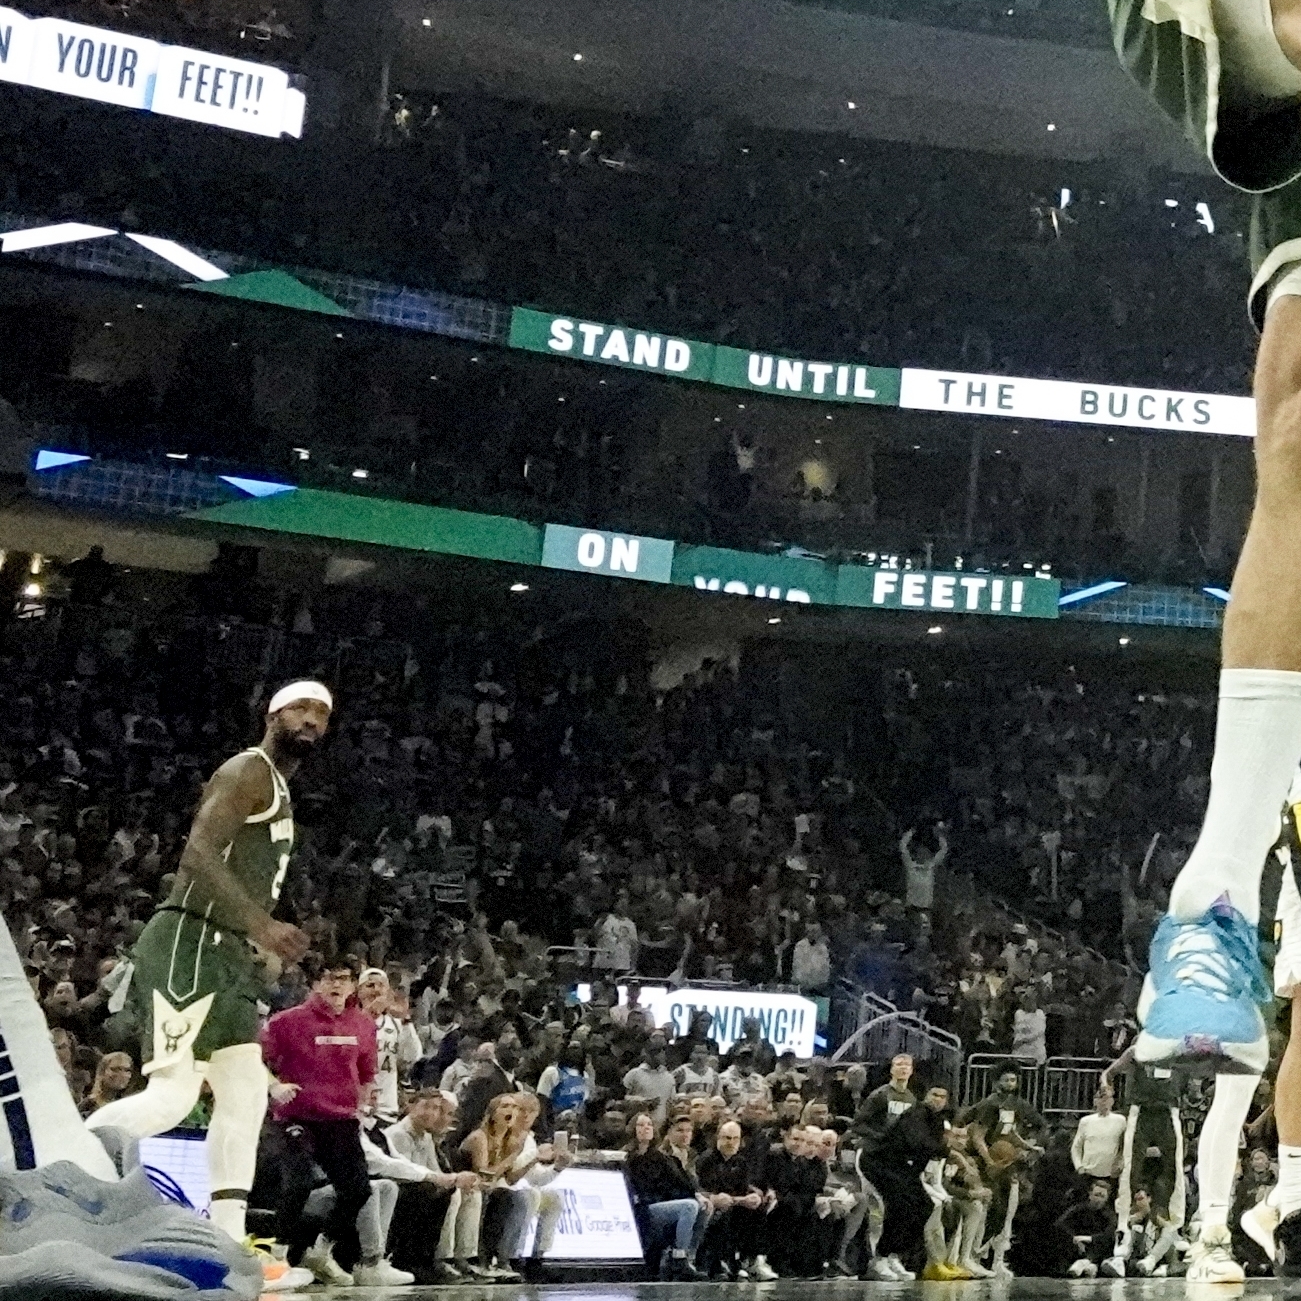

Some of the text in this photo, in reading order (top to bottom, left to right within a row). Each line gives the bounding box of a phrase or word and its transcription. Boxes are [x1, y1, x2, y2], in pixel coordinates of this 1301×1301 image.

[57, 32, 139, 88] YOUR
[178, 60, 264, 115] FEET!!
[548, 318, 691, 372] STAND
[747, 352, 876, 399] UNTIL
[938, 378, 1016, 410] THE
[1080, 389, 1212, 425] BUCKS
[577, 533, 1024, 613] ON FEET!!
[670, 1003, 805, 1046] STNDNG!!
